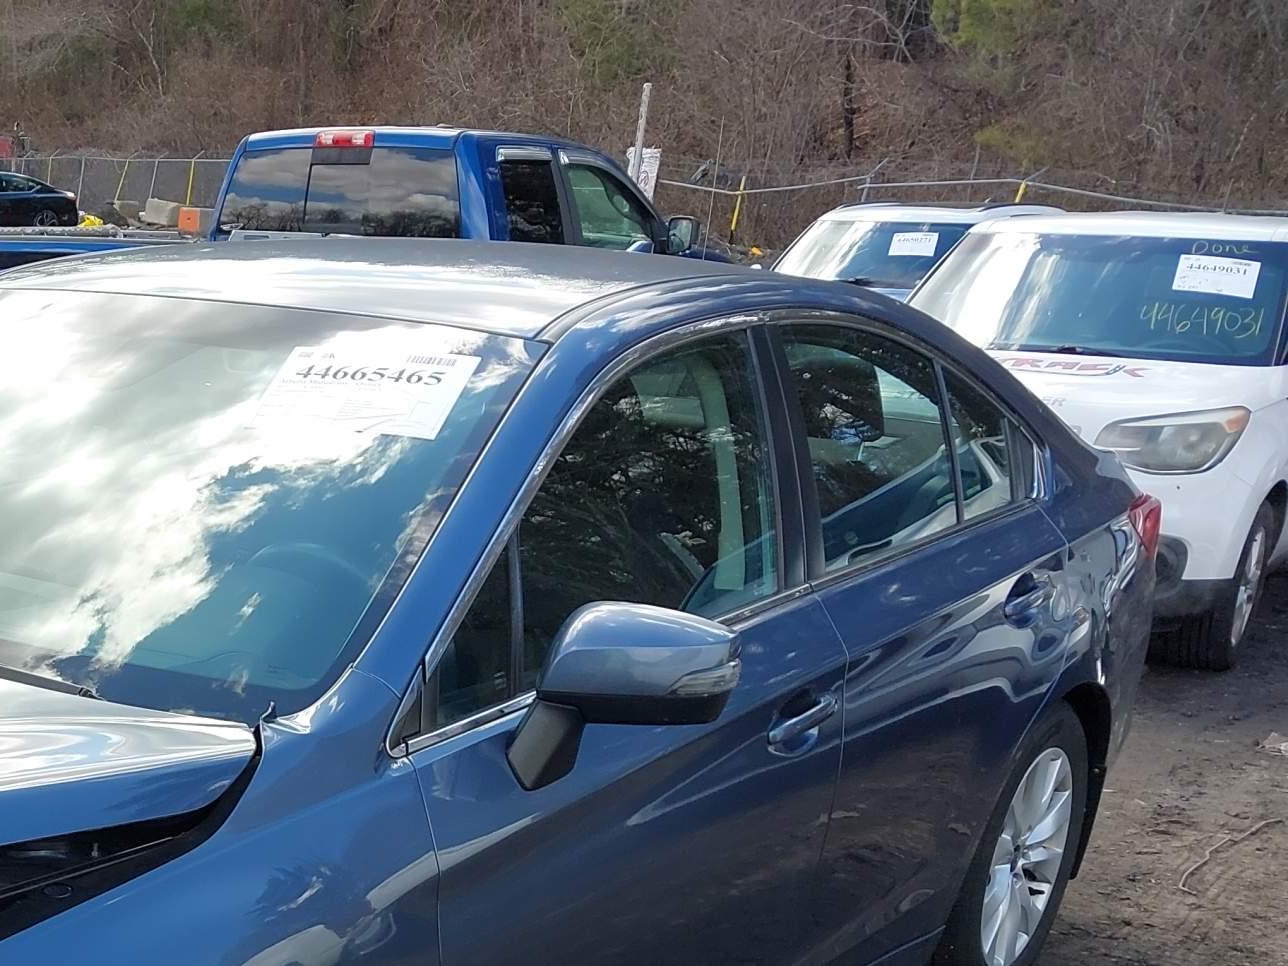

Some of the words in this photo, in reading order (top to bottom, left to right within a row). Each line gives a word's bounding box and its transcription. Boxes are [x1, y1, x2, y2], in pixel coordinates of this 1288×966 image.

[1192, 240, 1259, 254] Done
[1186, 262, 1248, 276] 44649031
[1139, 301, 1265, 339] 44649031
[295, 364, 446, 386] 44665465
